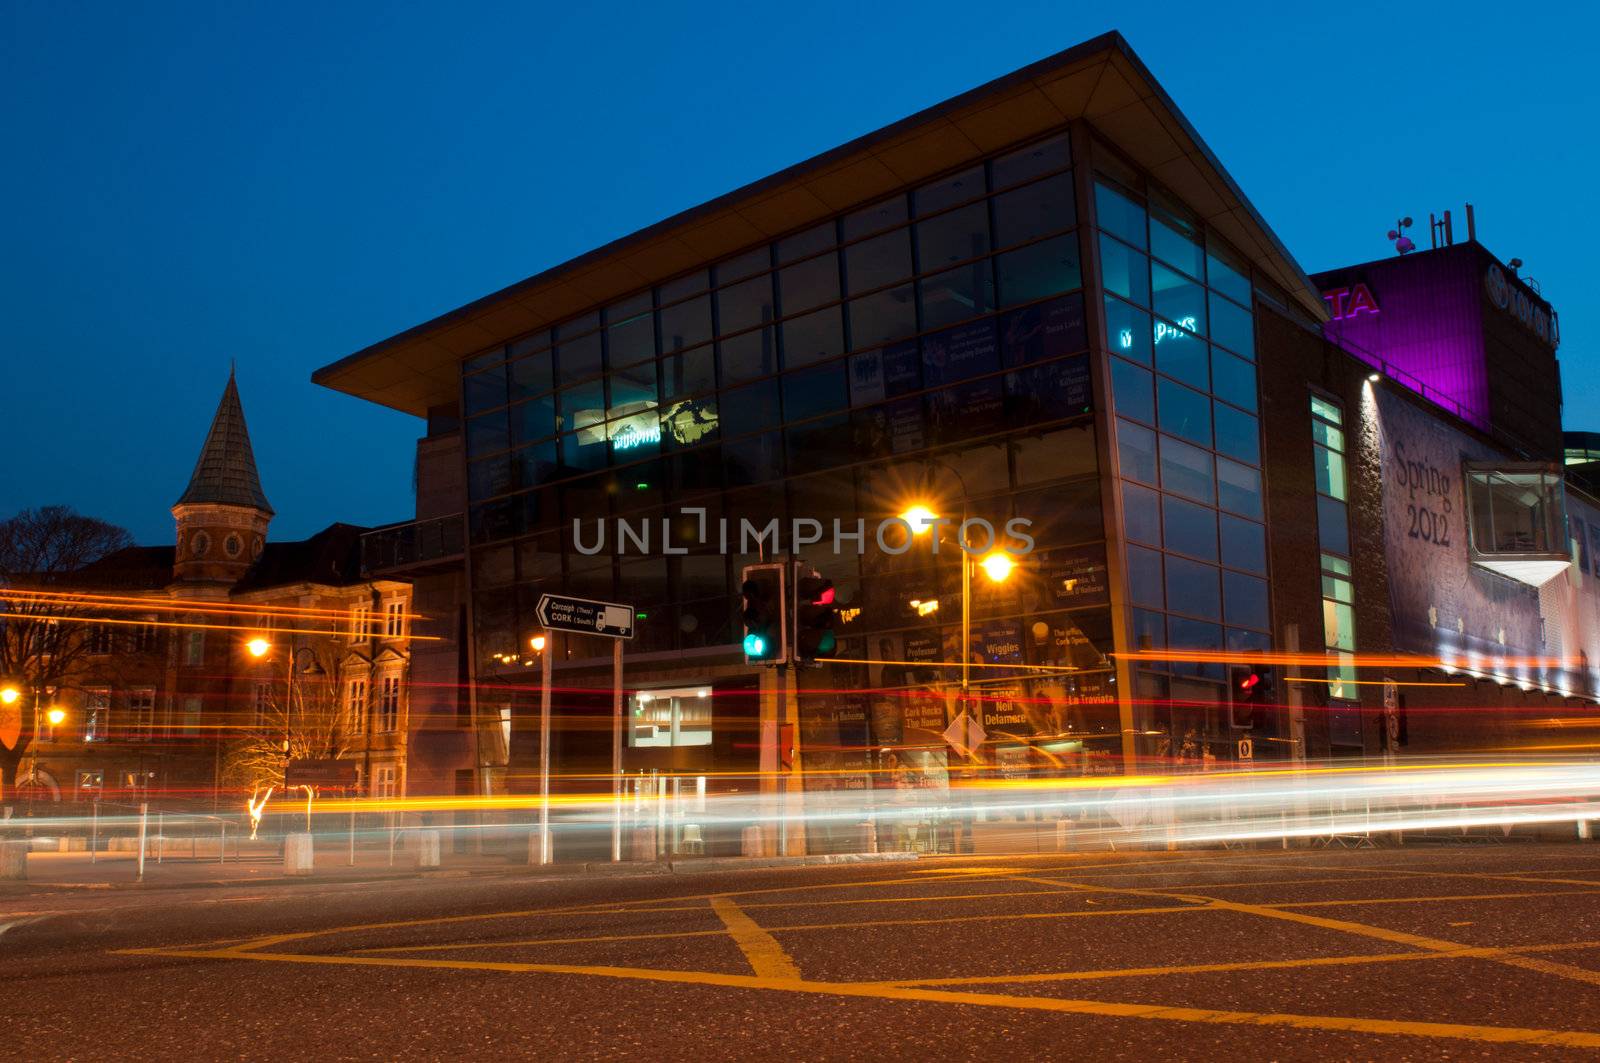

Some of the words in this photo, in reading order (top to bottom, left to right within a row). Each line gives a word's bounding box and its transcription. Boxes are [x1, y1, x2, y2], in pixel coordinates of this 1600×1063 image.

[1395, 440, 1451, 513] Spring
[1407, 504, 1450, 548] 2012
[551, 612, 572, 622] CORK
[986, 642, 1019, 655] Wiggles
[1080, 693, 1114, 705] Traviata
[996, 701, 1013, 711] Neil
[985, 713, 1027, 726] Delamere
